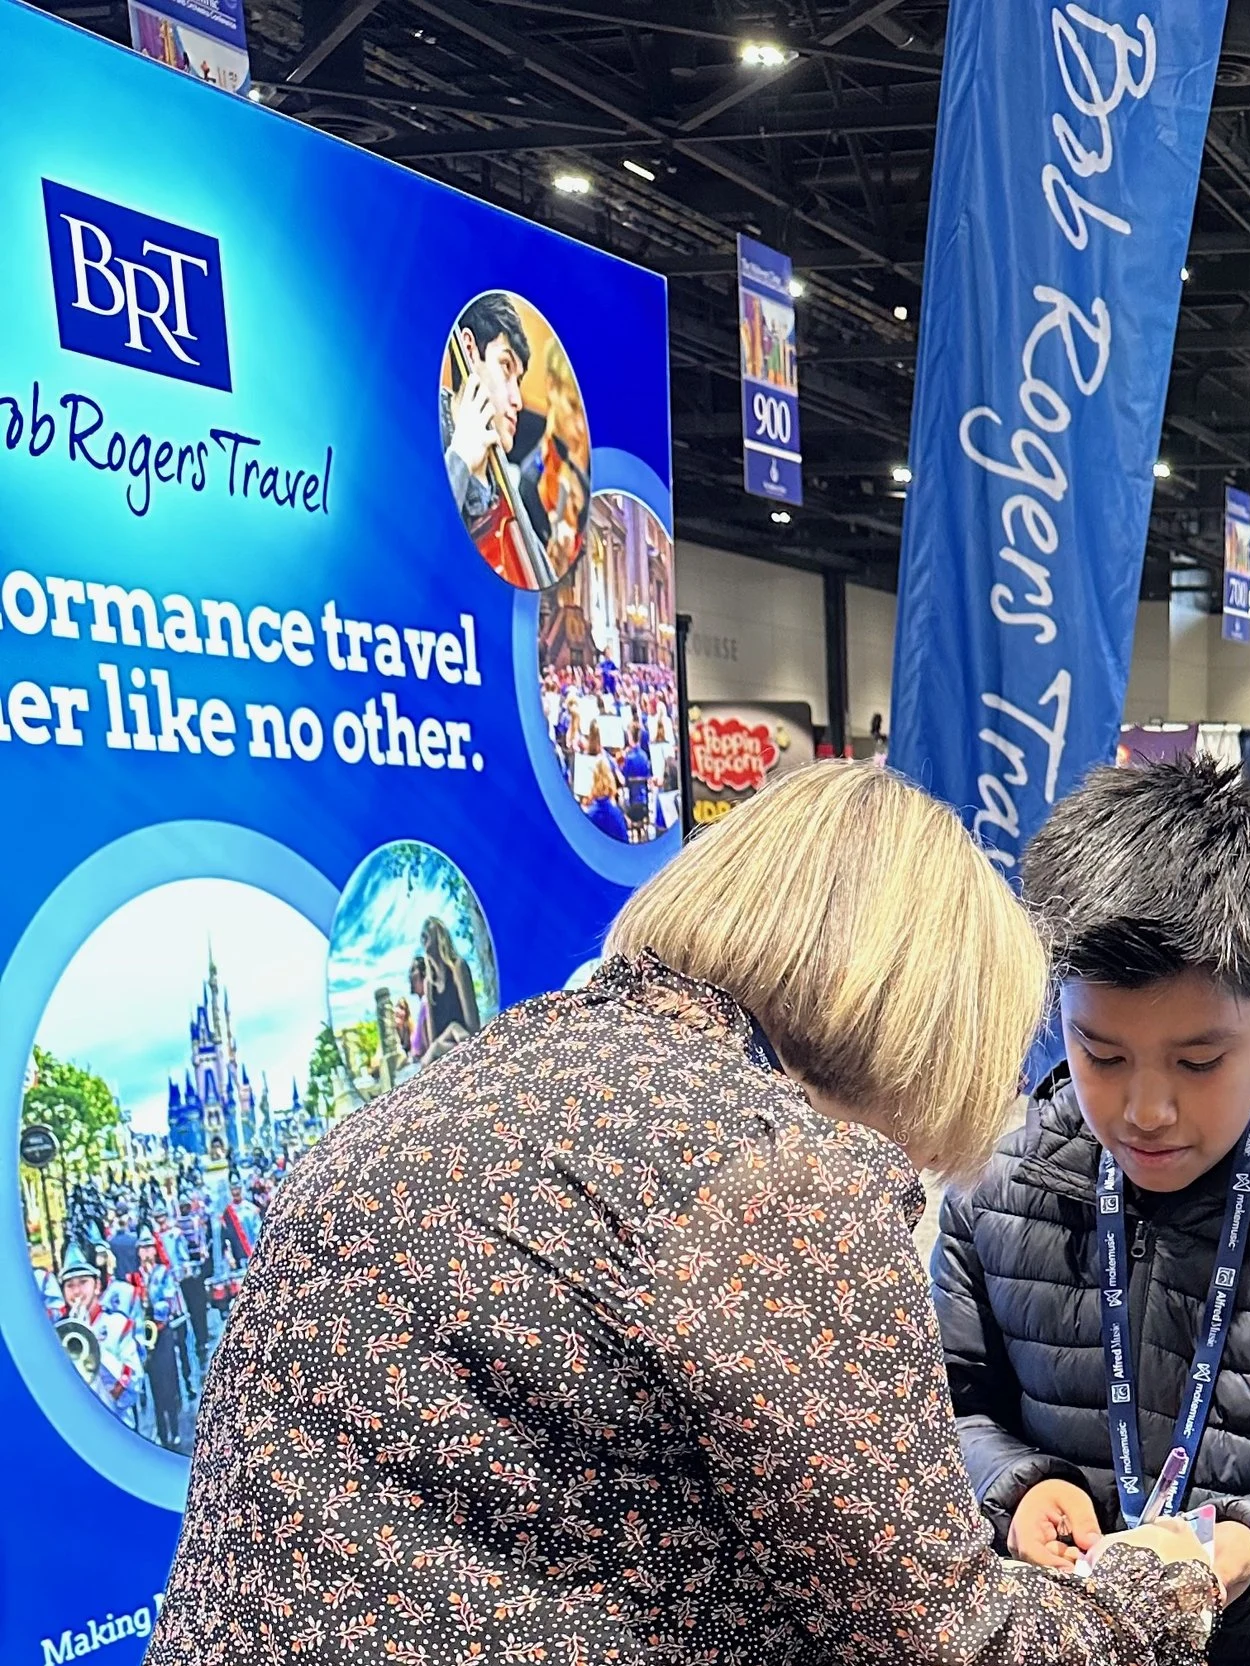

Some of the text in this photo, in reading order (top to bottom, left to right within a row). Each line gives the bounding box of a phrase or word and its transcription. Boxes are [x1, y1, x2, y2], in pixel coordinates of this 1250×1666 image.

[1041, 2, 1157, 251] Bob
[60, 212, 209, 367] BRT
[753, 392, 791, 444] 900
[0, 380, 334, 517] ob Rogers Travel
[959, 285, 1112, 644] Rogers
[1229, 577, 1249, 607] 700
[0, 569, 482, 687] ormance travel
[0, 662, 485, 773] er like no other.
[703, 724, 761, 760] Poppin
[694, 743, 764, 782] Popcorn
[1227, 1193, 1245, 1252] makemusic
[1104, 1230, 1118, 1287] makemusic
[1211, 1290, 1227, 1323] Alfred
[1111, 1348, 1125, 1379] Alfred
[1183, 1383, 1204, 1439] makemusic
[1116, 1419, 1132, 1475] makemusic
